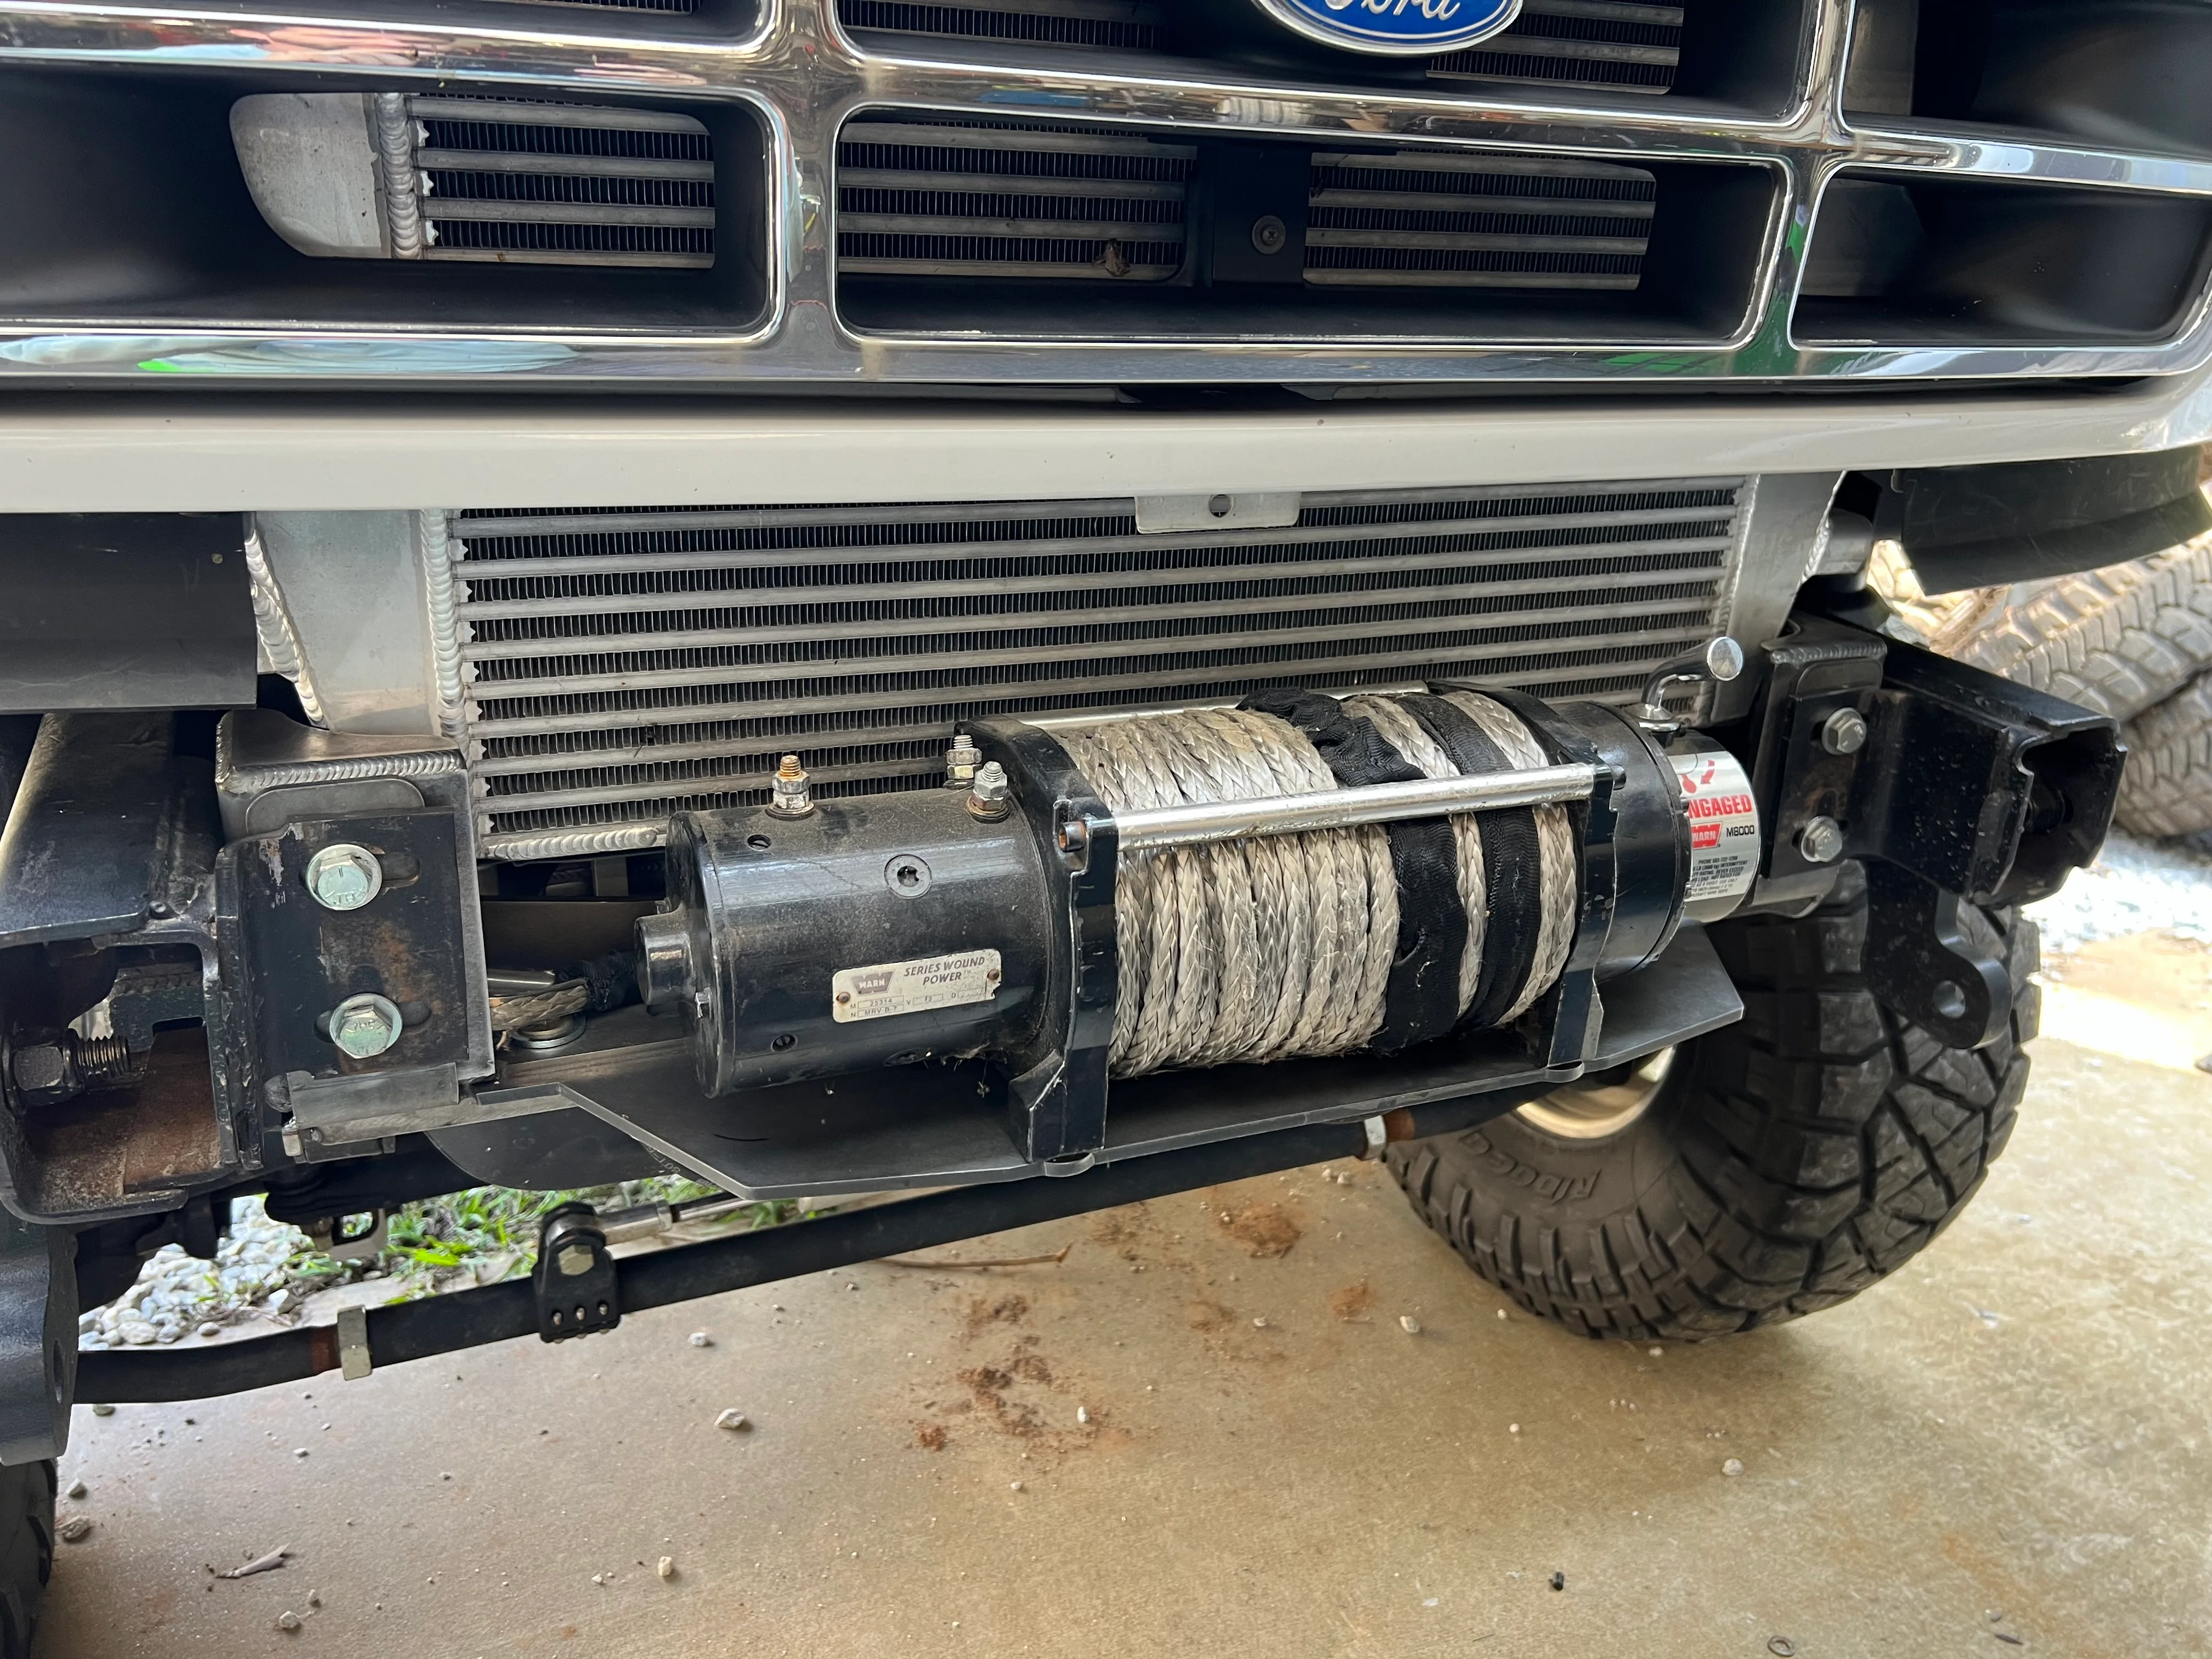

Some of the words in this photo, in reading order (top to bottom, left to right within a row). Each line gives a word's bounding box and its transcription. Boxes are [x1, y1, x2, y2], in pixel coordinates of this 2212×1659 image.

[1688, 795, 1752, 819] NGAGED
[1692, 831, 1716, 842] WARN
[1726, 825, 1755, 837] M8000
[904, 963, 940, 977] SERIES
[944, 957, 985, 972] WOUND
[859, 978, 885, 989] WARN
